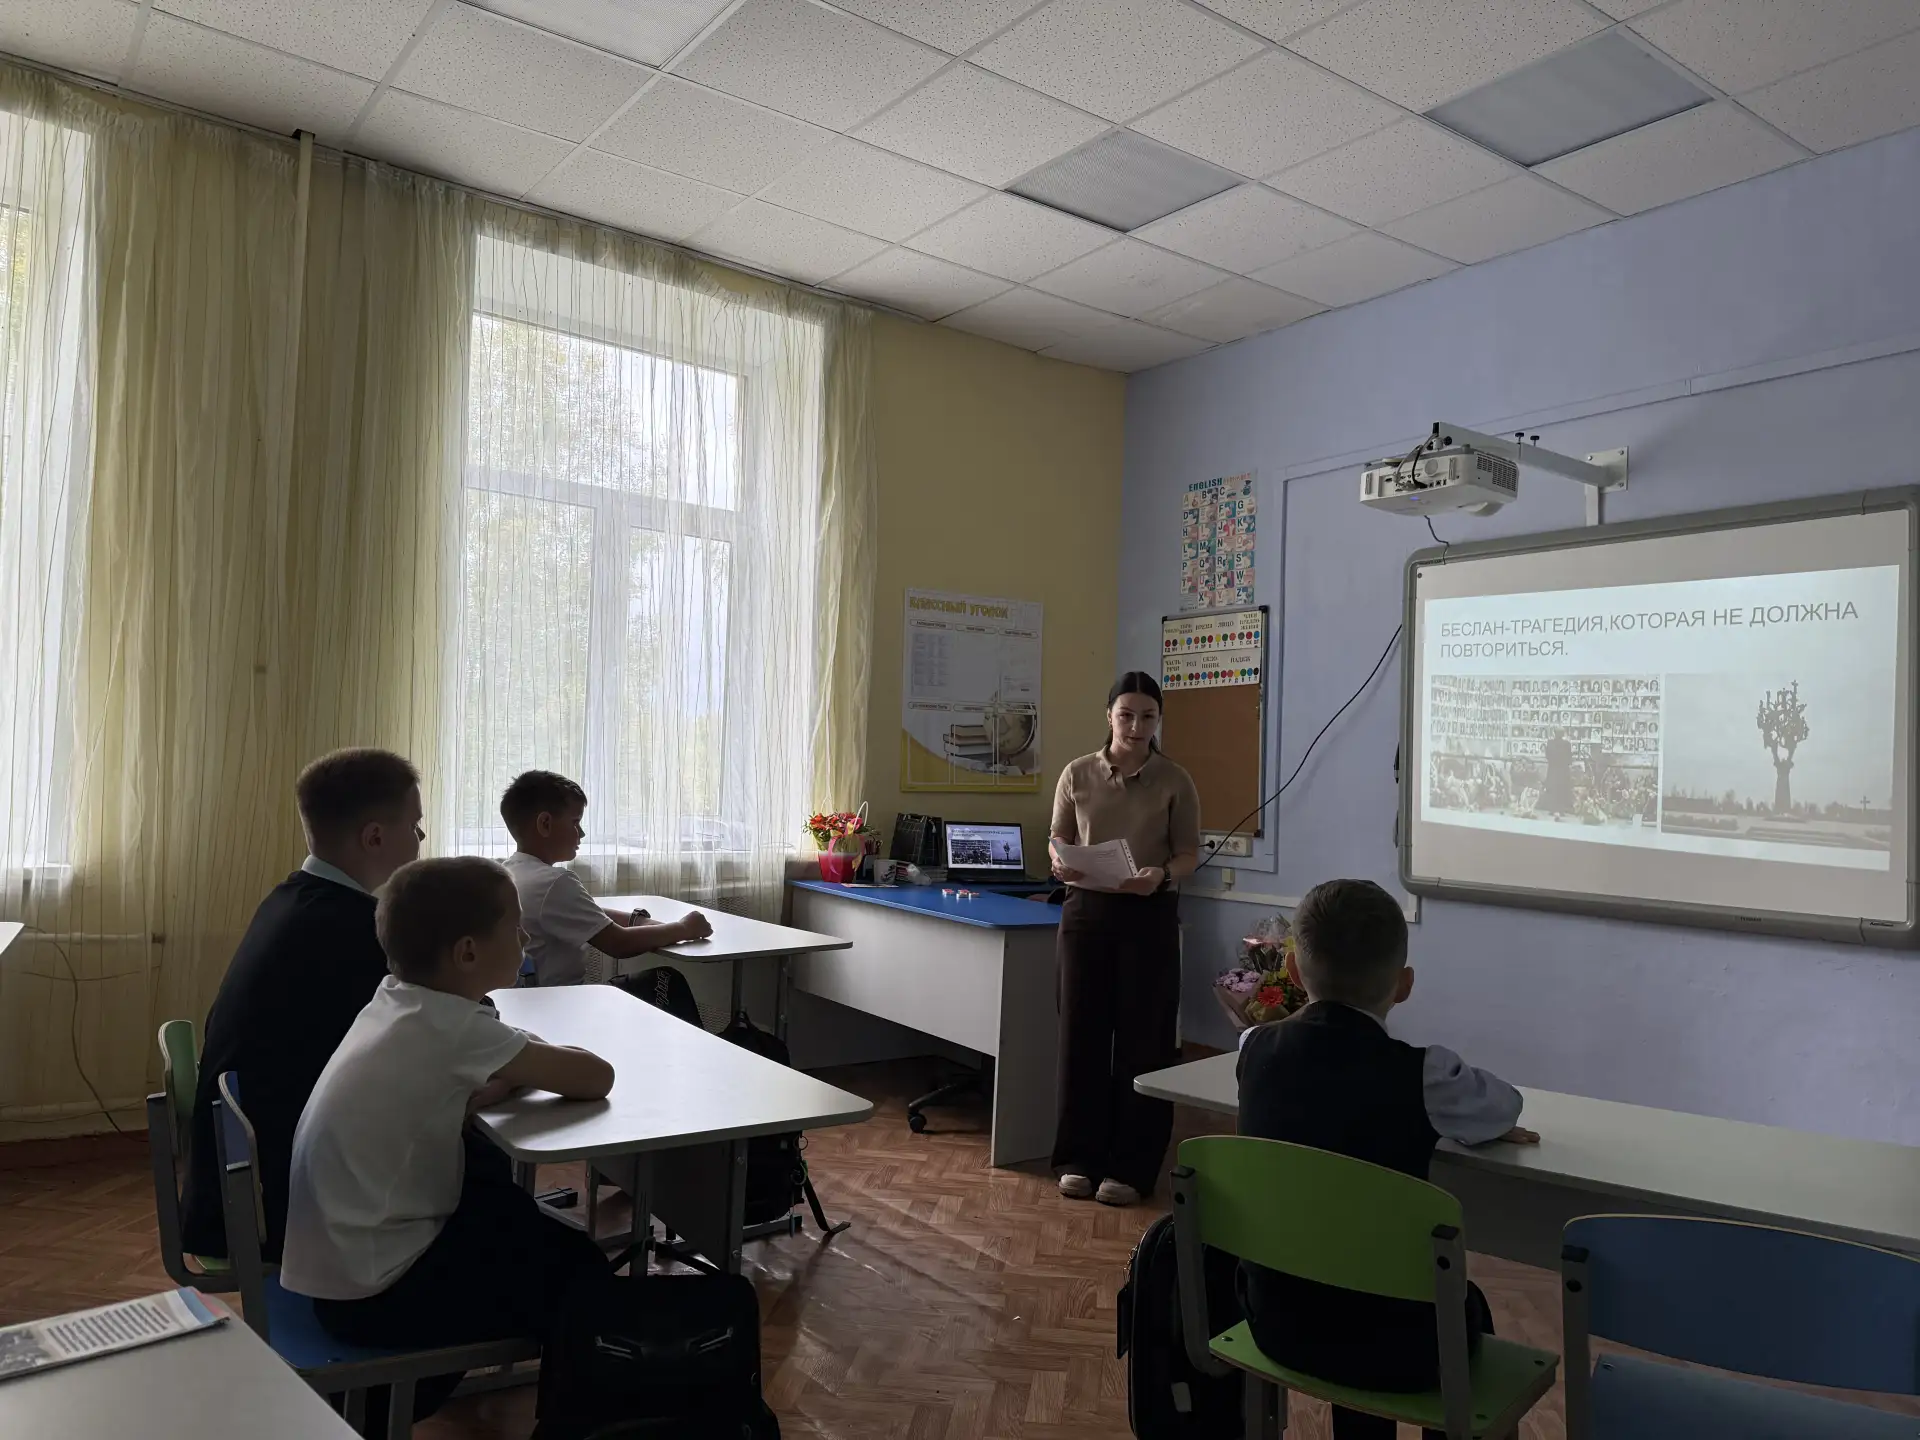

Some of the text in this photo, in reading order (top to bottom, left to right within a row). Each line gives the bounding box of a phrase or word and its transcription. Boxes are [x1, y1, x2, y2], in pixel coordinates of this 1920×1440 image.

[1189, 477, 1223, 491] ENGLISH
[1713, 608, 1743, 626] НЕ
[1749, 601, 1859, 627] ДОЛЖНА
[1440, 640, 1568, 658] ПОВТОРИТЬСЯ.
